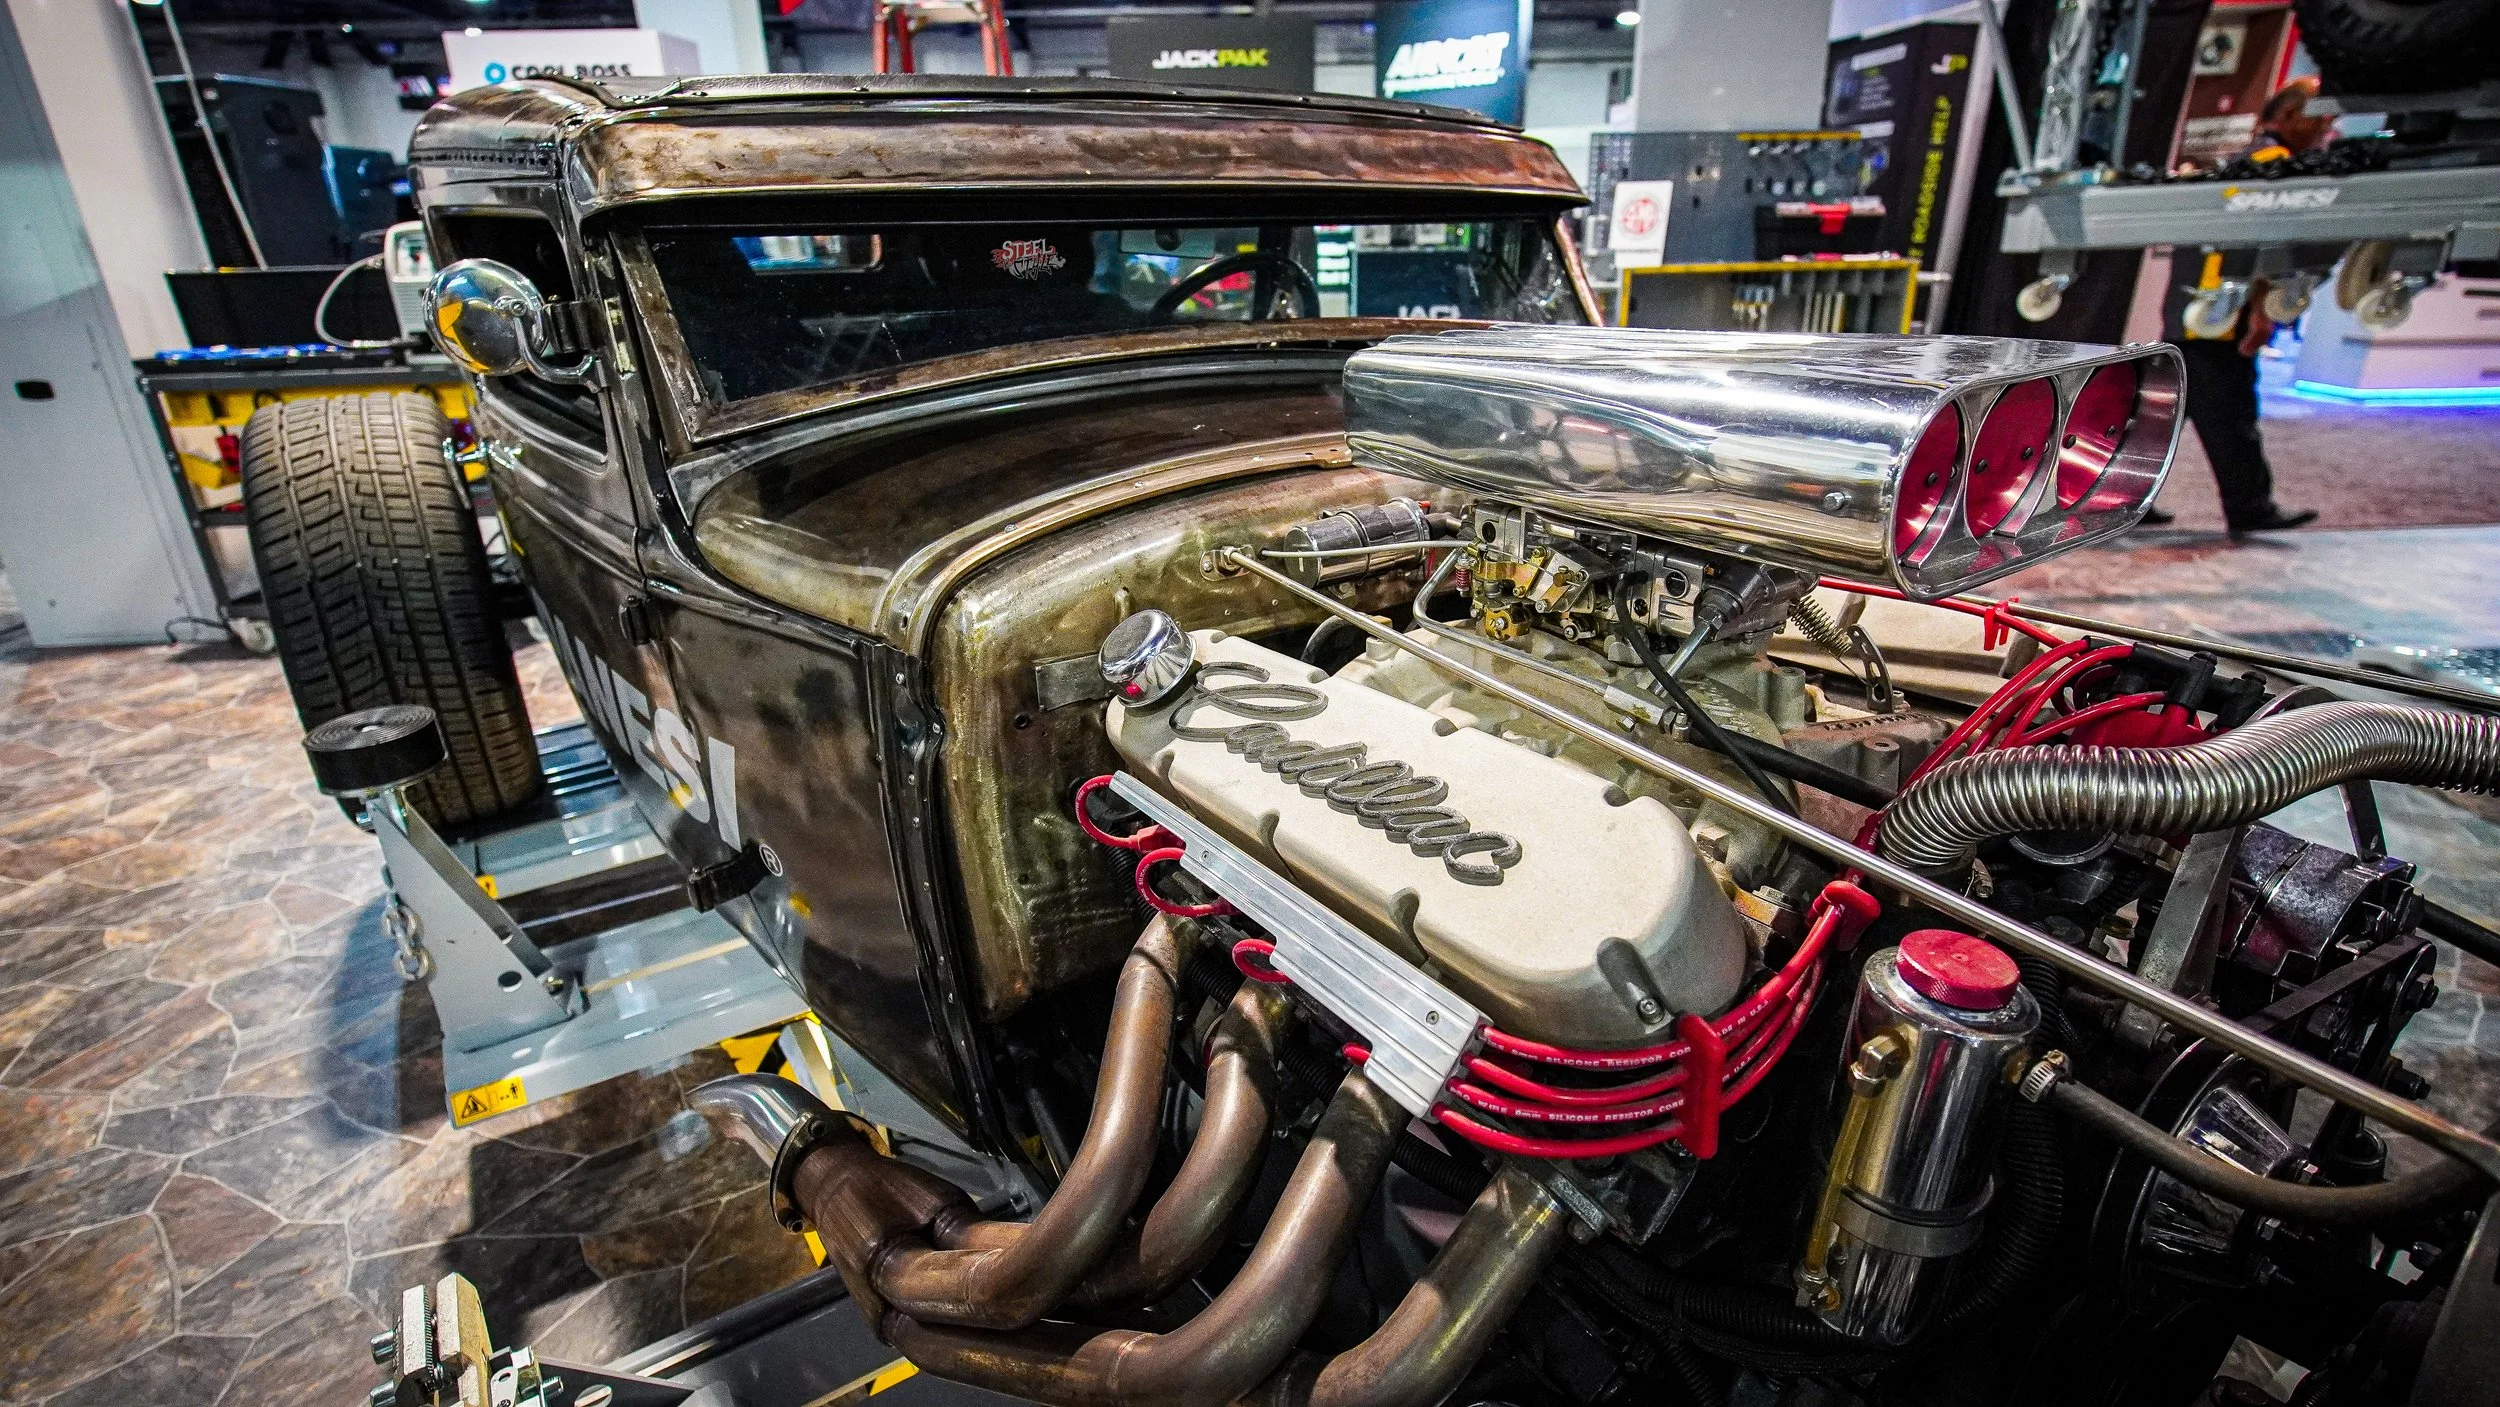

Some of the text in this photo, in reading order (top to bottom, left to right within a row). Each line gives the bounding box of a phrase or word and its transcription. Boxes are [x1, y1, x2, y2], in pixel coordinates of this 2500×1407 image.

[1151, 47, 1269, 69] JACKPAK
[1928, 95, 1951, 145] HELP
[1002, 238, 1053, 260] STEEL
[1169, 661, 1522, 886] Cadillac
[1545, 1056, 1600, 1067] SILICONE
[1606, 1054, 1663, 1067] RESISTOR
[1669, 1046, 1691, 1058] COR
[1548, 1113, 1599, 1122] SILICONE
[1604, 1108, 1654, 1121] RESISTOR
